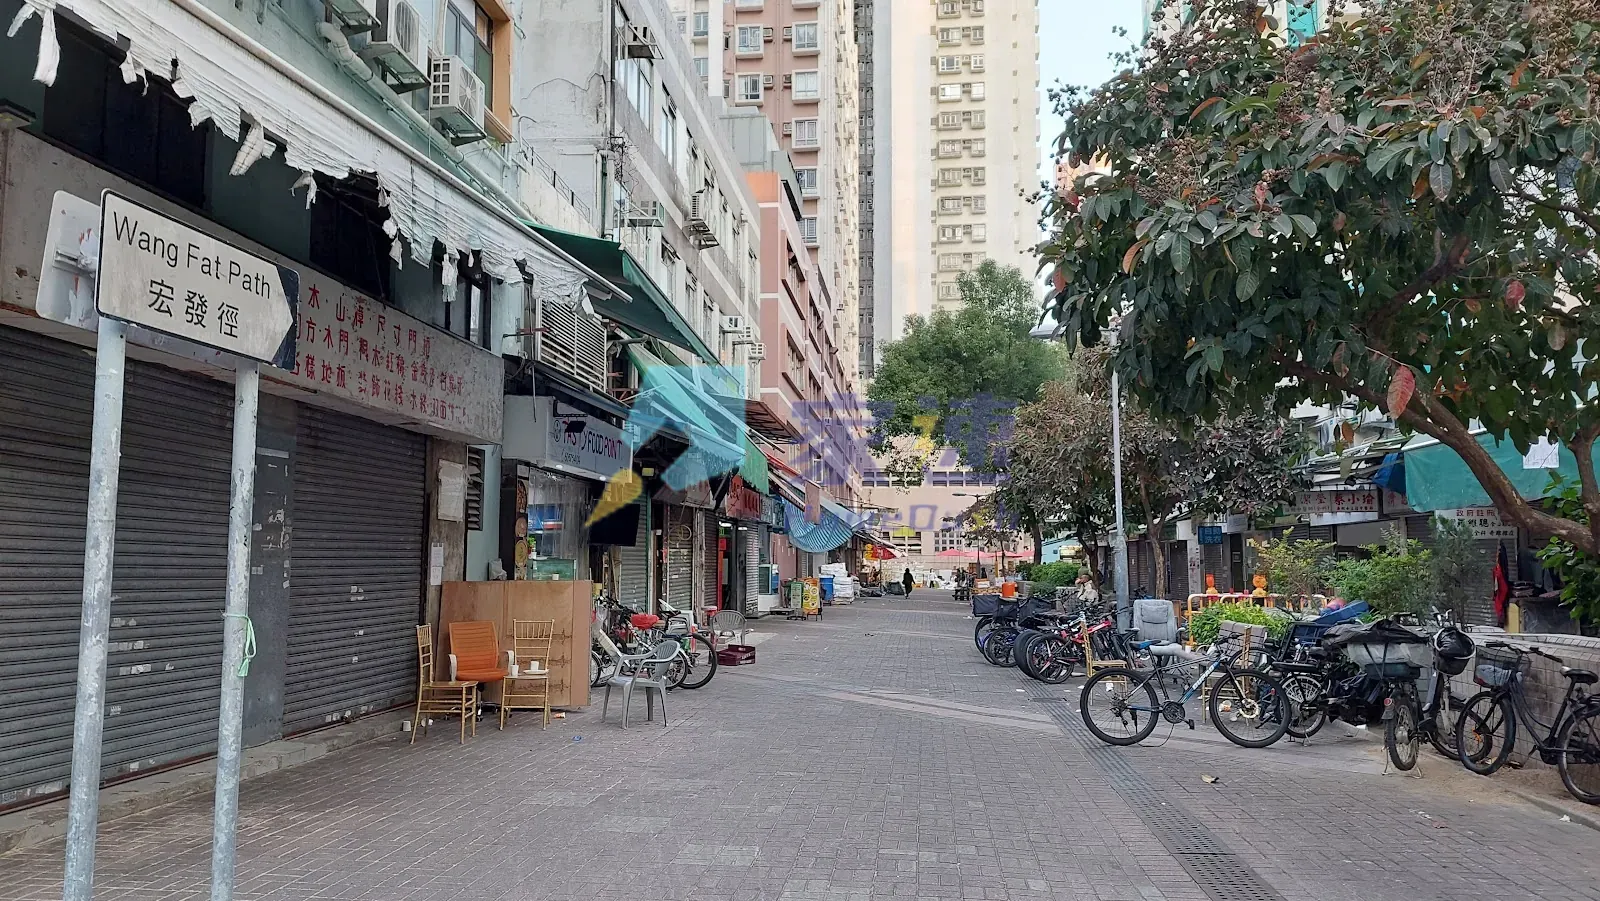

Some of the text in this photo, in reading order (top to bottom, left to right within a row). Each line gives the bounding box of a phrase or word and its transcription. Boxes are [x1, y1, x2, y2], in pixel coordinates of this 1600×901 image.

[113, 211, 271, 299] Wang Fat Path
[147, 279, 240, 339] 宏發徑
